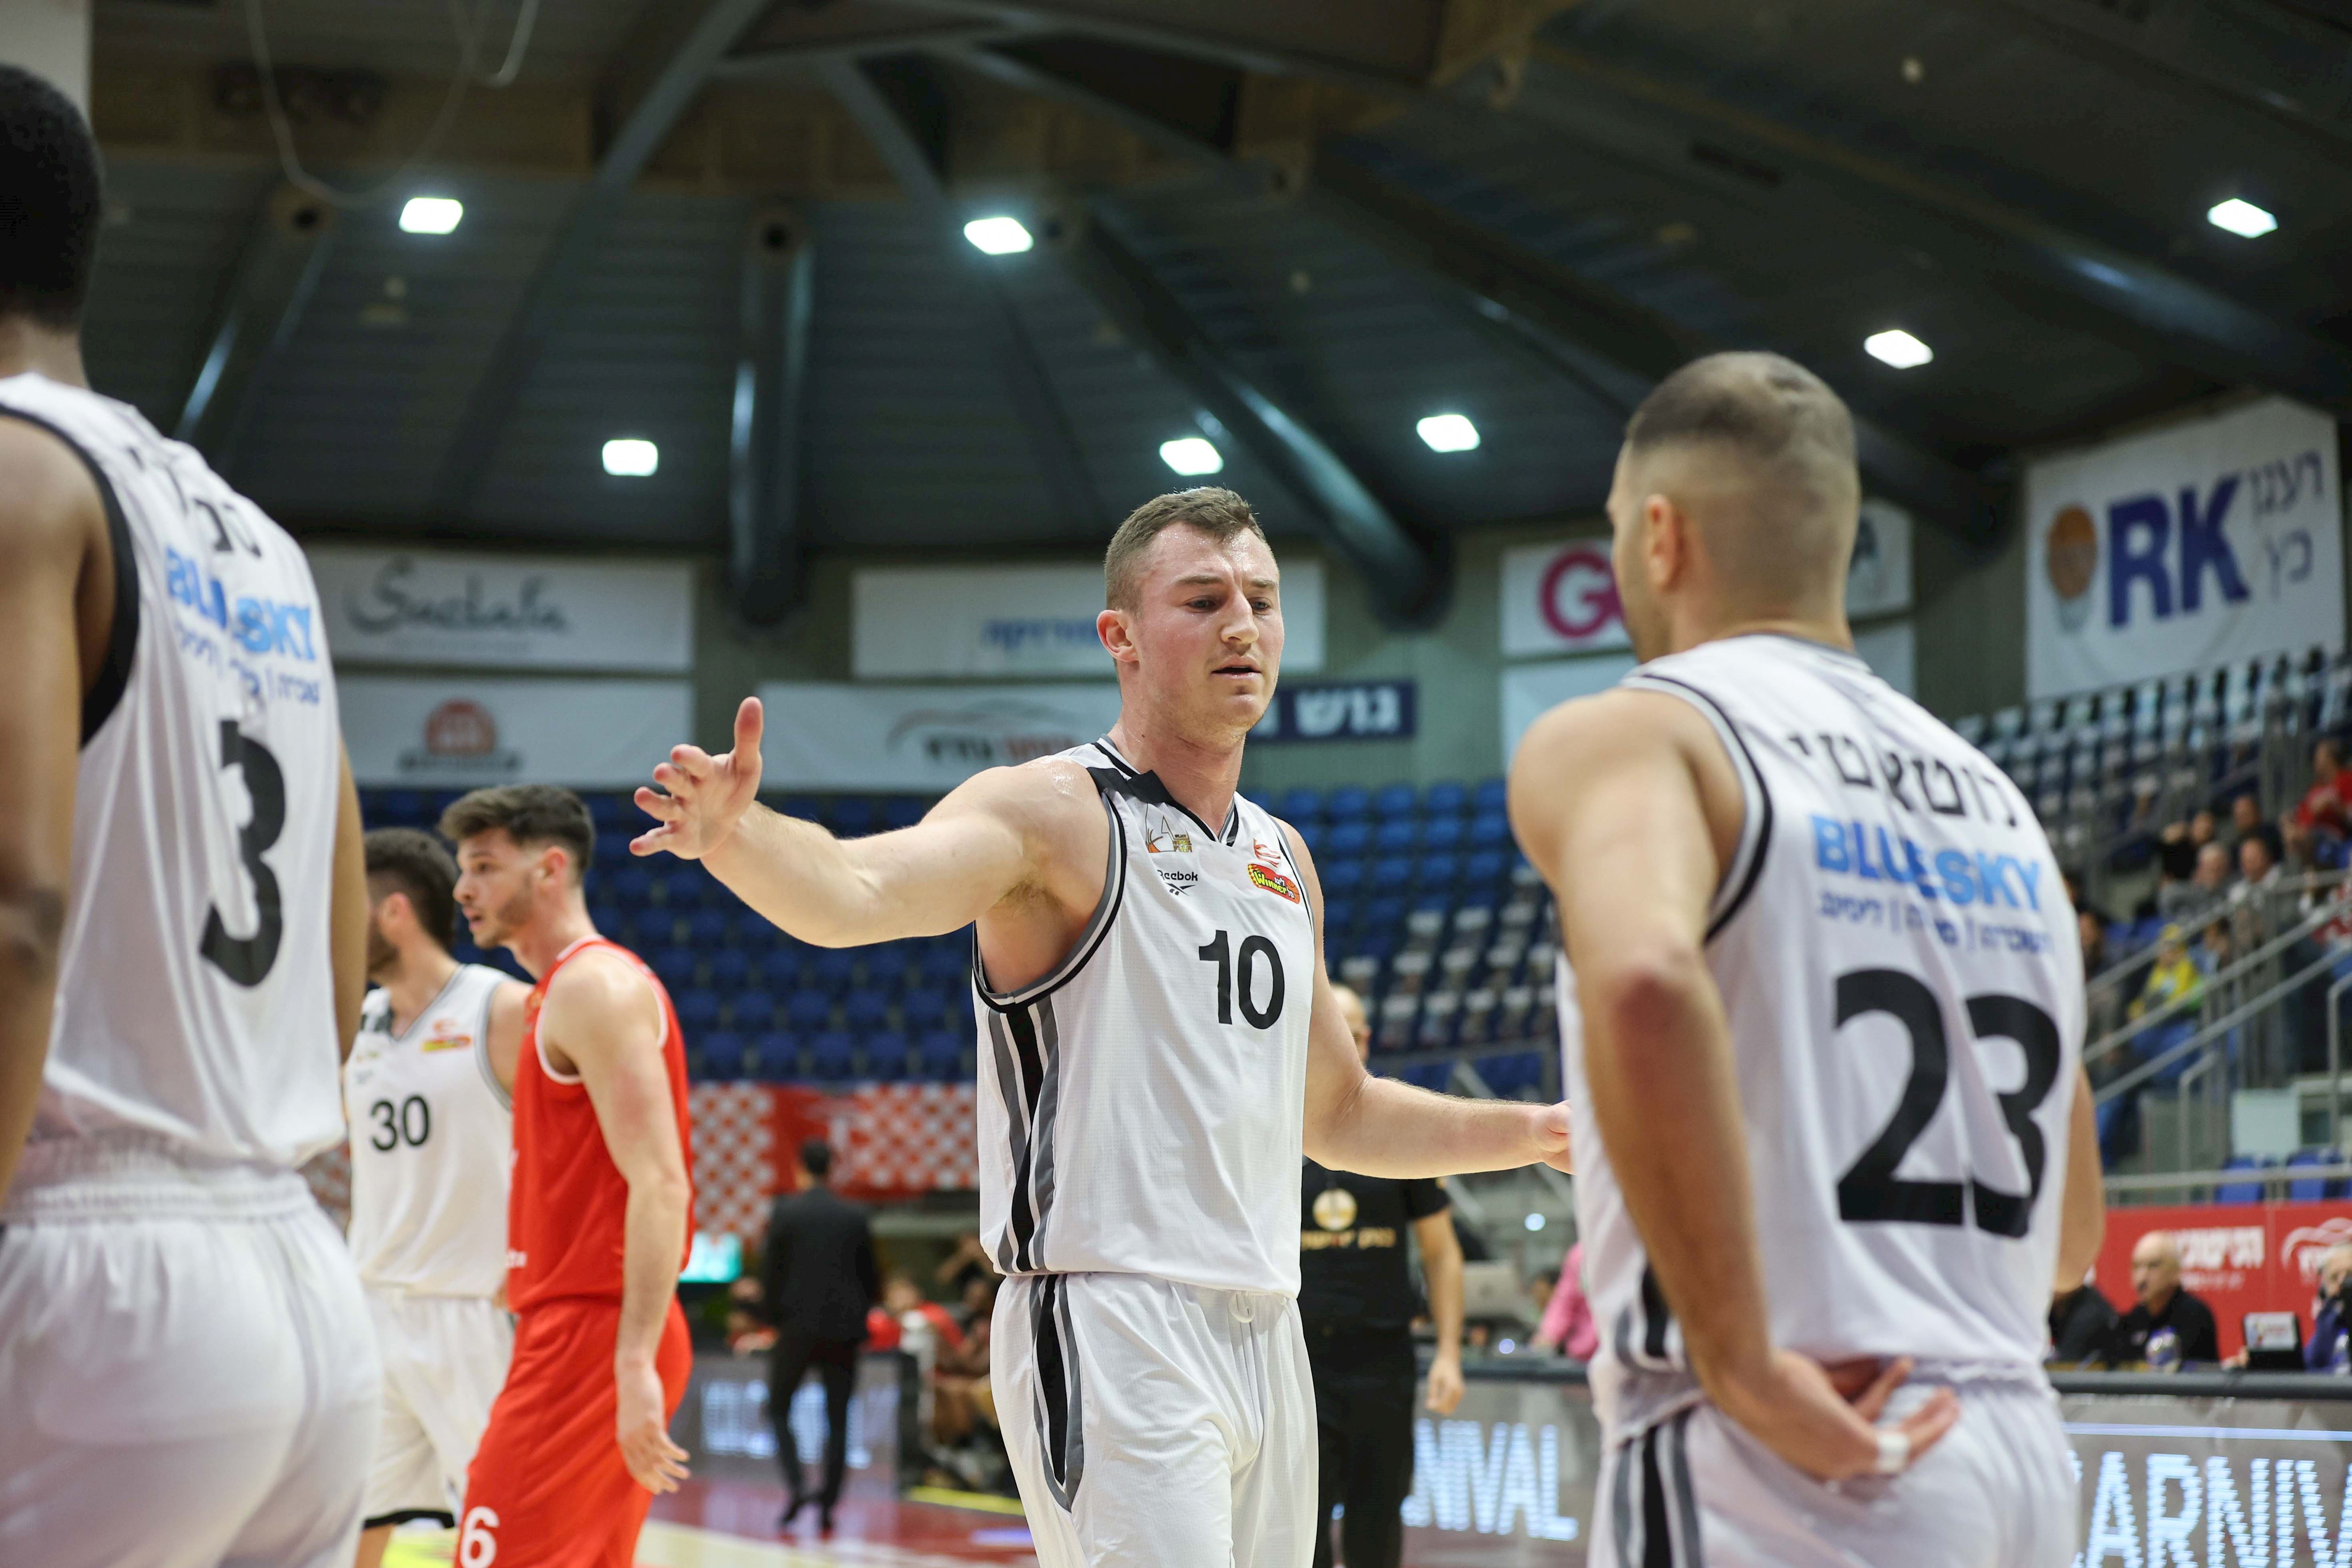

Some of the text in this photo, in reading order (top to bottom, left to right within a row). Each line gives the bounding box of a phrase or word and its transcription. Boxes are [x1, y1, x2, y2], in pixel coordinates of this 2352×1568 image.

[1539, 551, 1621, 639] G
[2108, 473, 2251, 627] RK
[2265, 528, 2313, 603] כץ
[200, 720, 286, 987] 3
[1199, 930, 1285, 1029] 10
[370, 1094, 430, 1153] 30
[1834, 967, 2060, 1239] 23
[1400, 1418, 1579, 1541] NIVAL
[460, 1505, 501, 1568] 6
